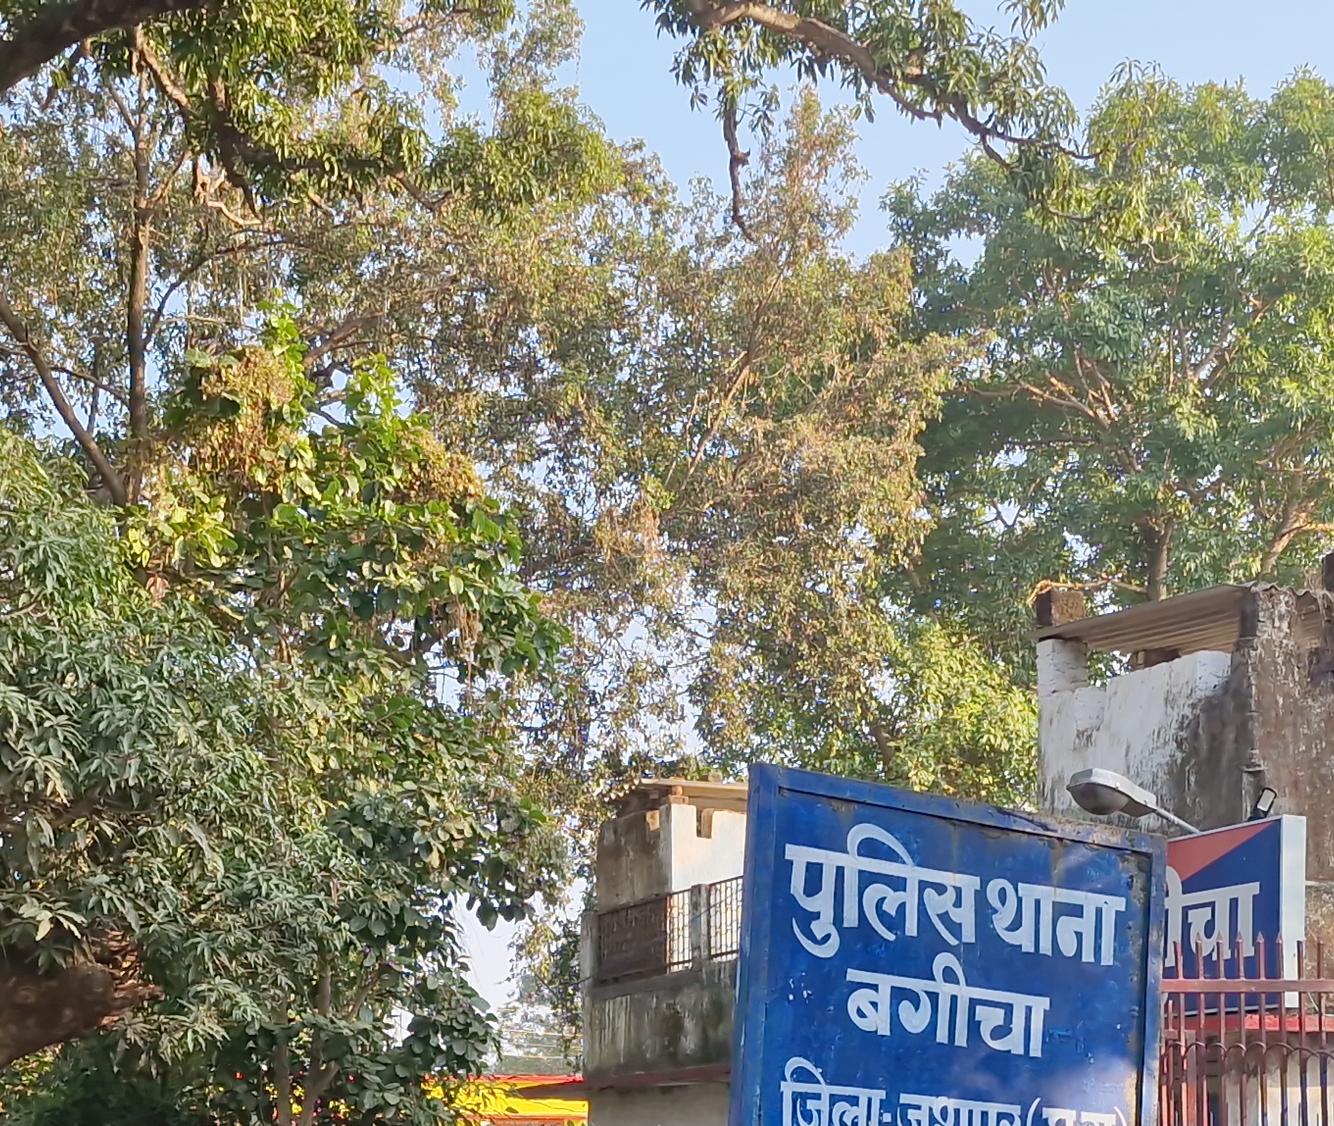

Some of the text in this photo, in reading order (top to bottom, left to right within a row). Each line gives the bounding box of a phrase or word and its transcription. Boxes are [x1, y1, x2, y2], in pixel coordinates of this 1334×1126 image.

[785, 823, 1126, 966] पुलिस थाना
[1165, 865, 1260, 967] ीचा
[846, 952, 1050, 1057] बगीचा
